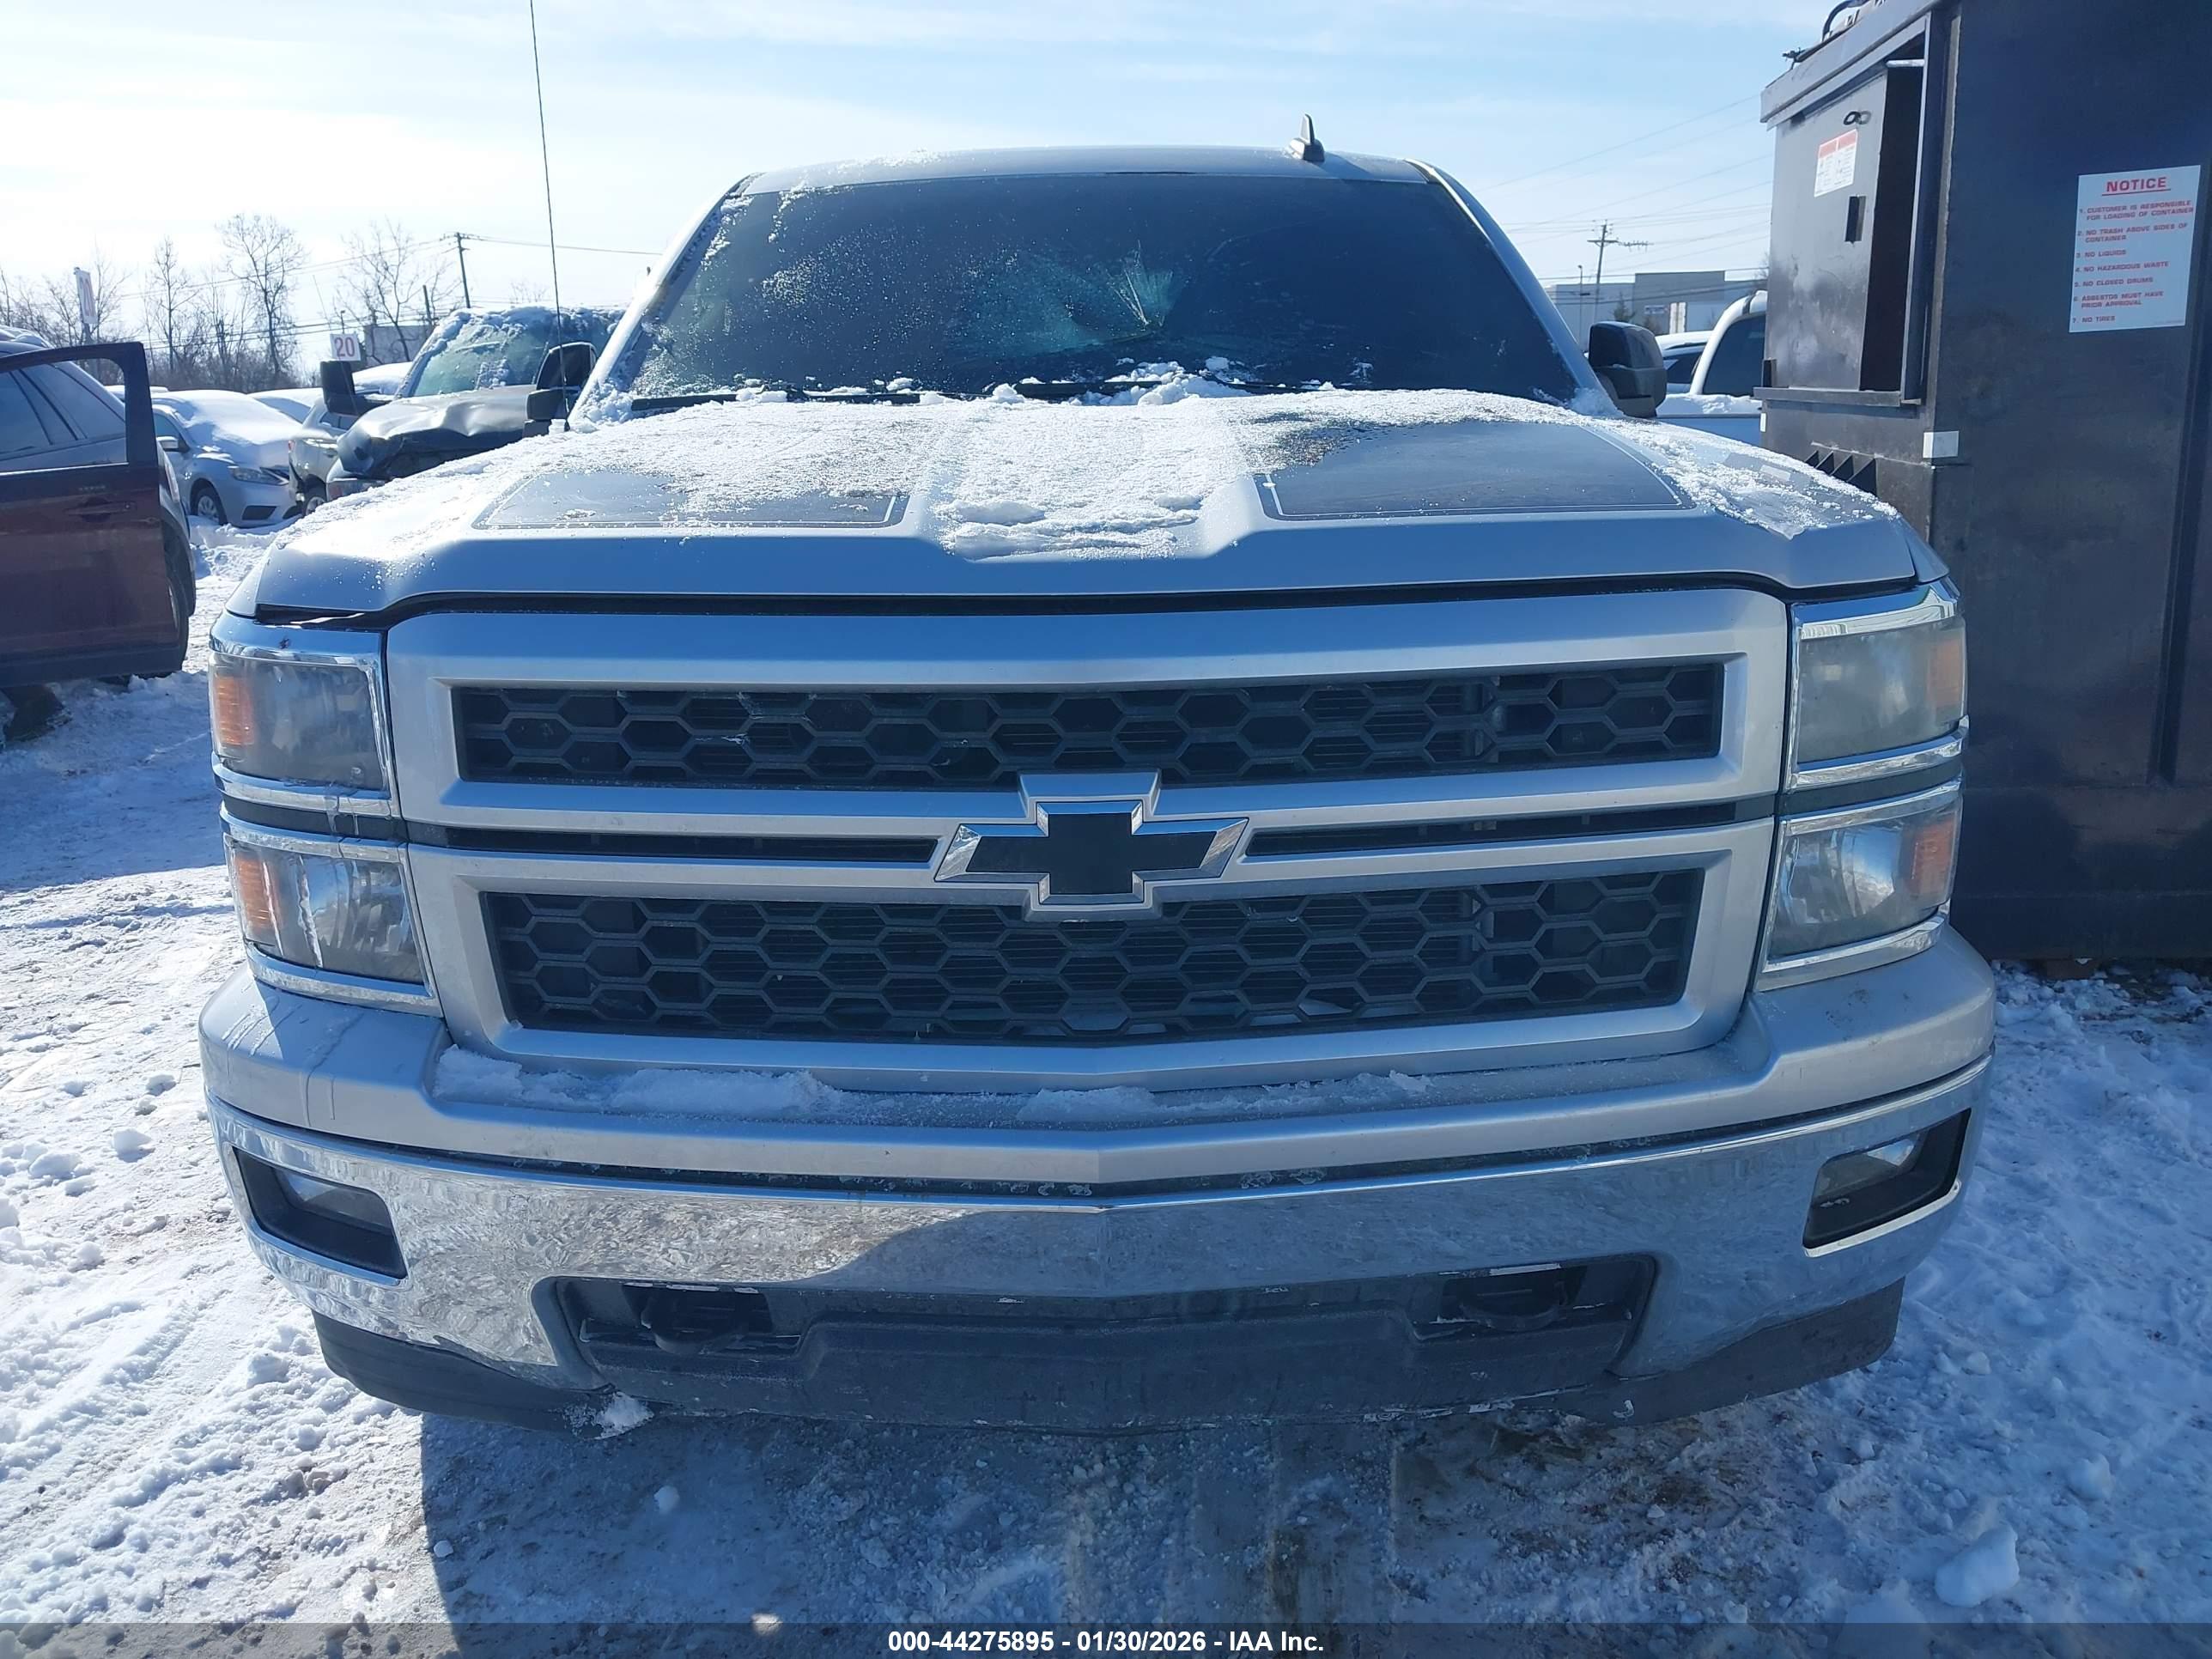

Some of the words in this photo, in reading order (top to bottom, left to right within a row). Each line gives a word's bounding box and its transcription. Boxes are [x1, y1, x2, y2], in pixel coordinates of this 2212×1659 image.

[2106, 177, 2166, 192] NOTICE
[2087, 205, 2127, 215] CUSTOMER
[2140, 200, 2191, 210] RESPONSIBLE
[2151, 207, 2194, 216] CONTAINER
[2085, 234, 2127, 243] CONTAINER
[2098, 249, 2127, 258] LIQUIDS
[2097, 264, 2142, 272] HAZARDOUS
[2127, 276, 2154, 285] DRUMS
[334, 337, 355, 357] 20
